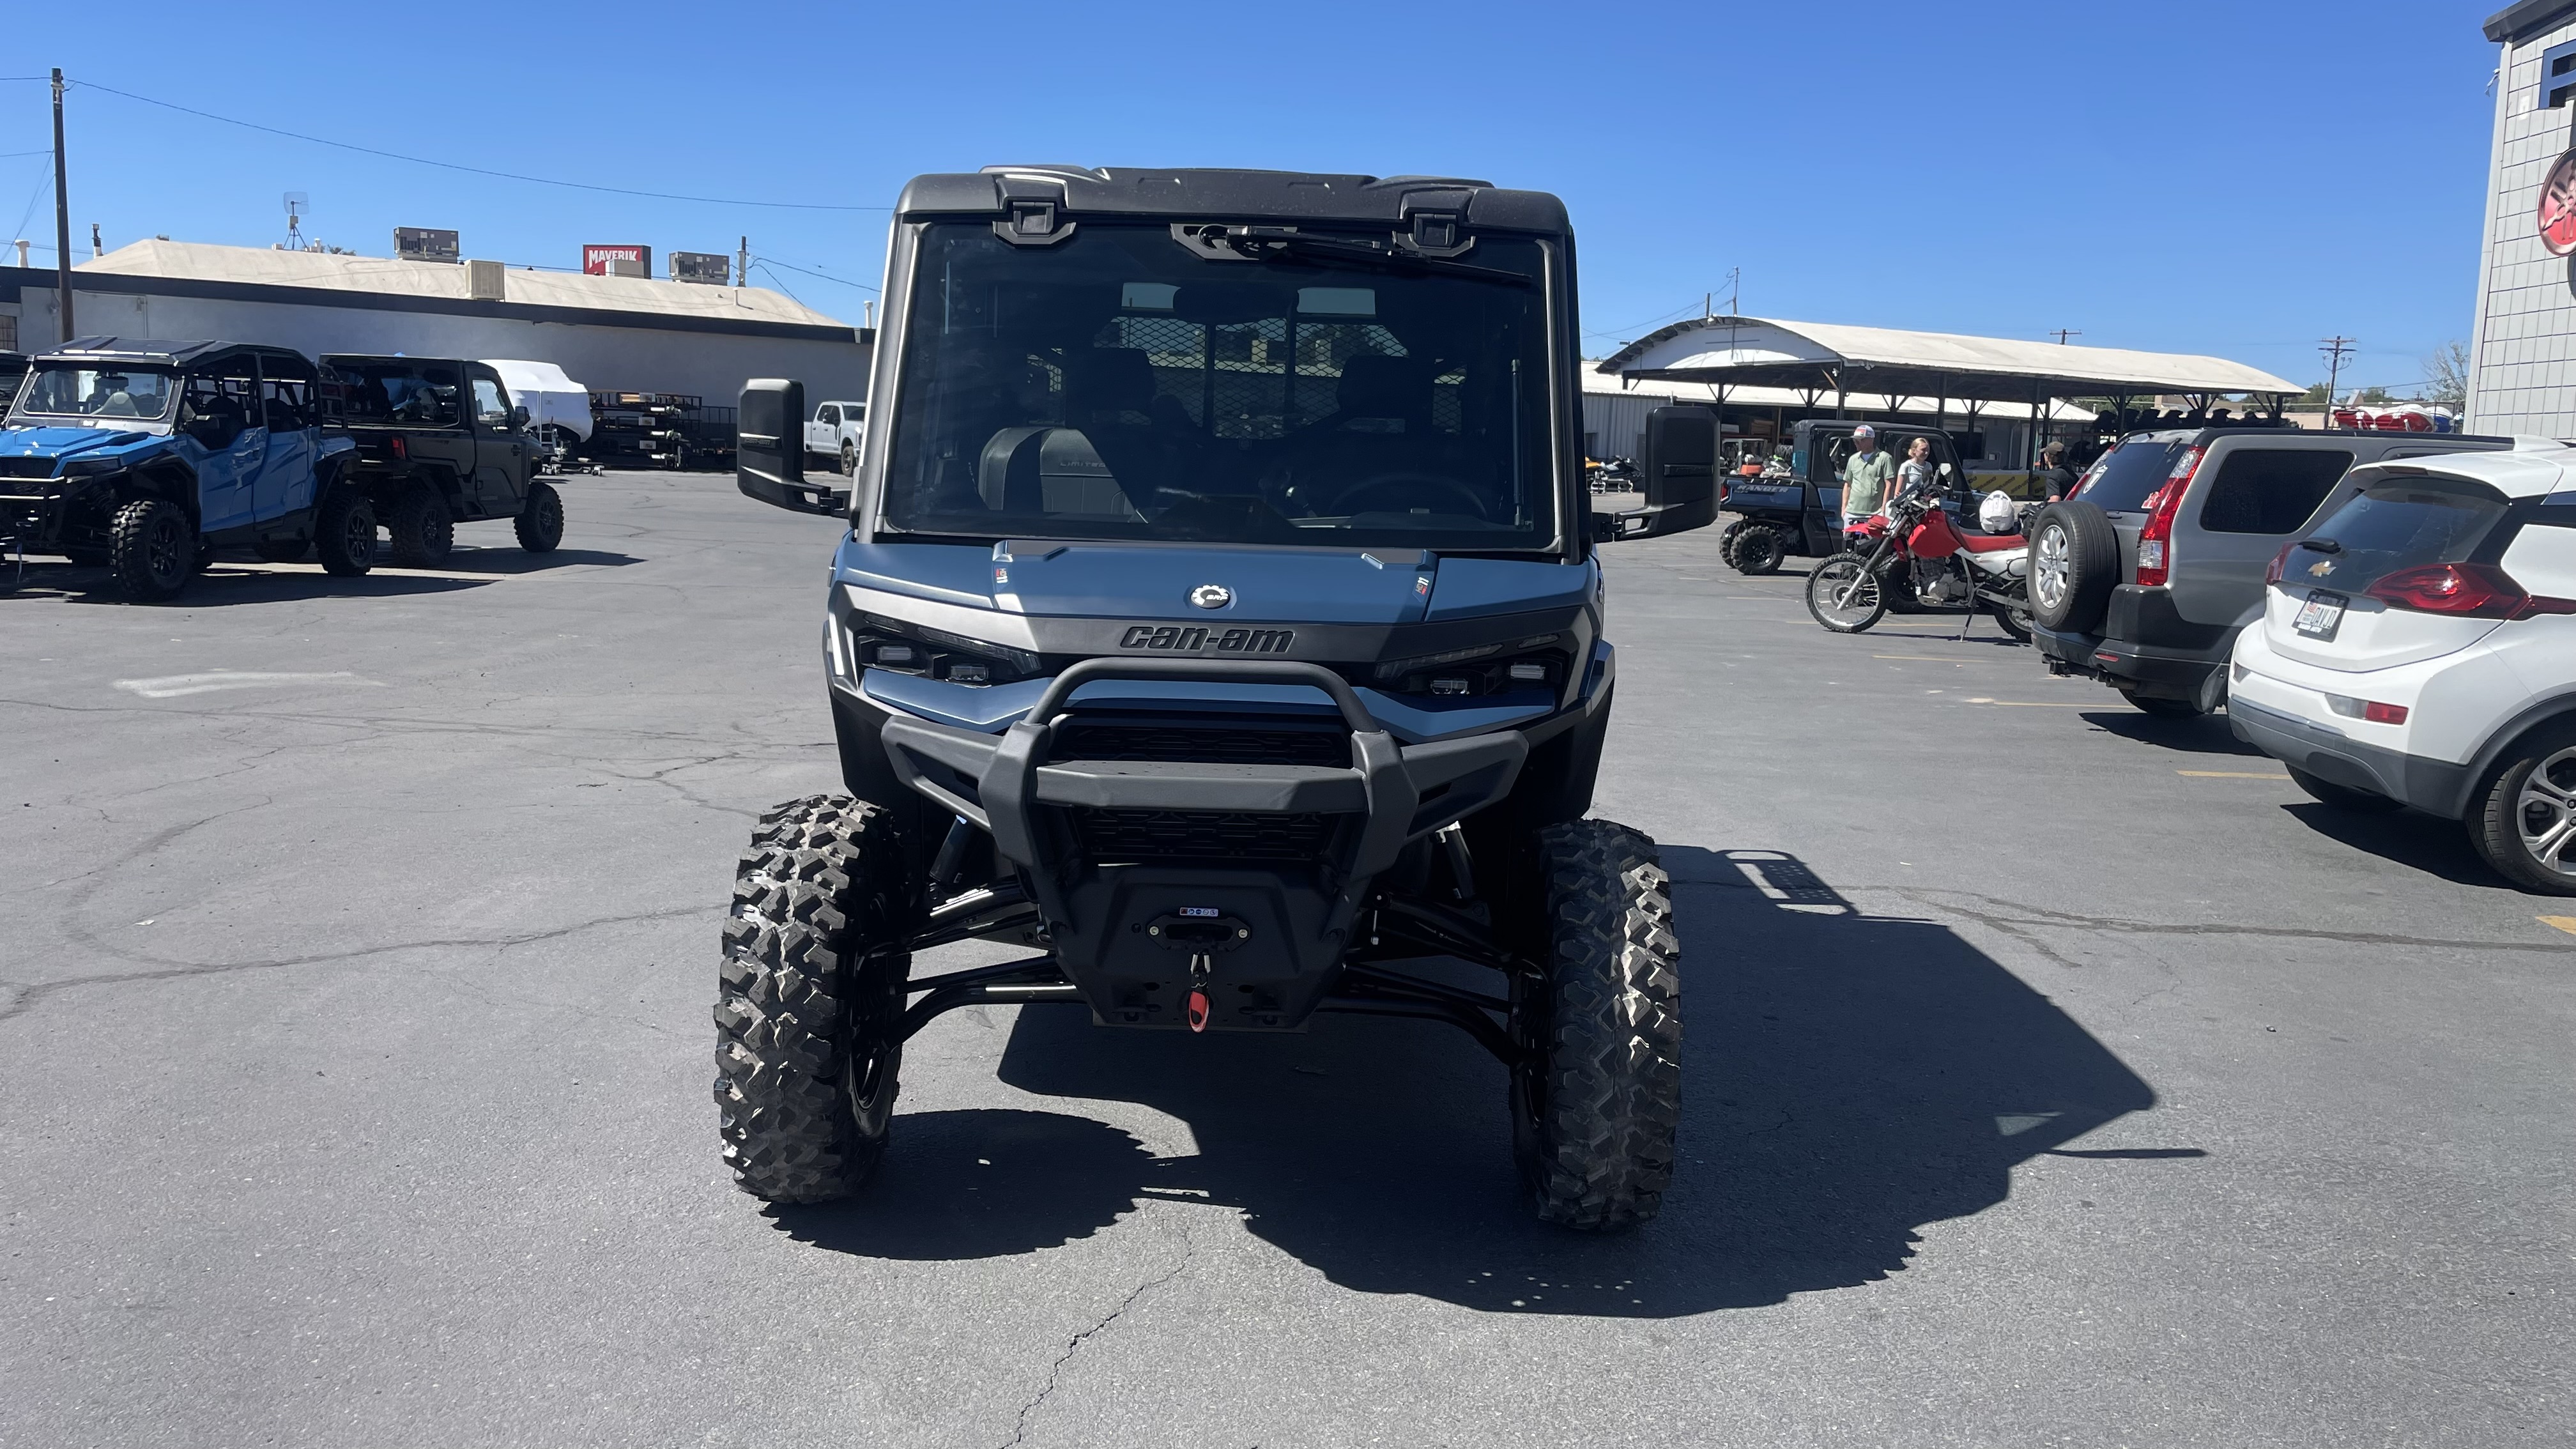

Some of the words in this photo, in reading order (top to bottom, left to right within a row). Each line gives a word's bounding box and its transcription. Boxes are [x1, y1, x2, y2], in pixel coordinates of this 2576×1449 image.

[588, 250, 638, 269] MAVERIK
[1736, 485, 1790, 493] RANGER
[1120, 626, 1296, 653] can-am
